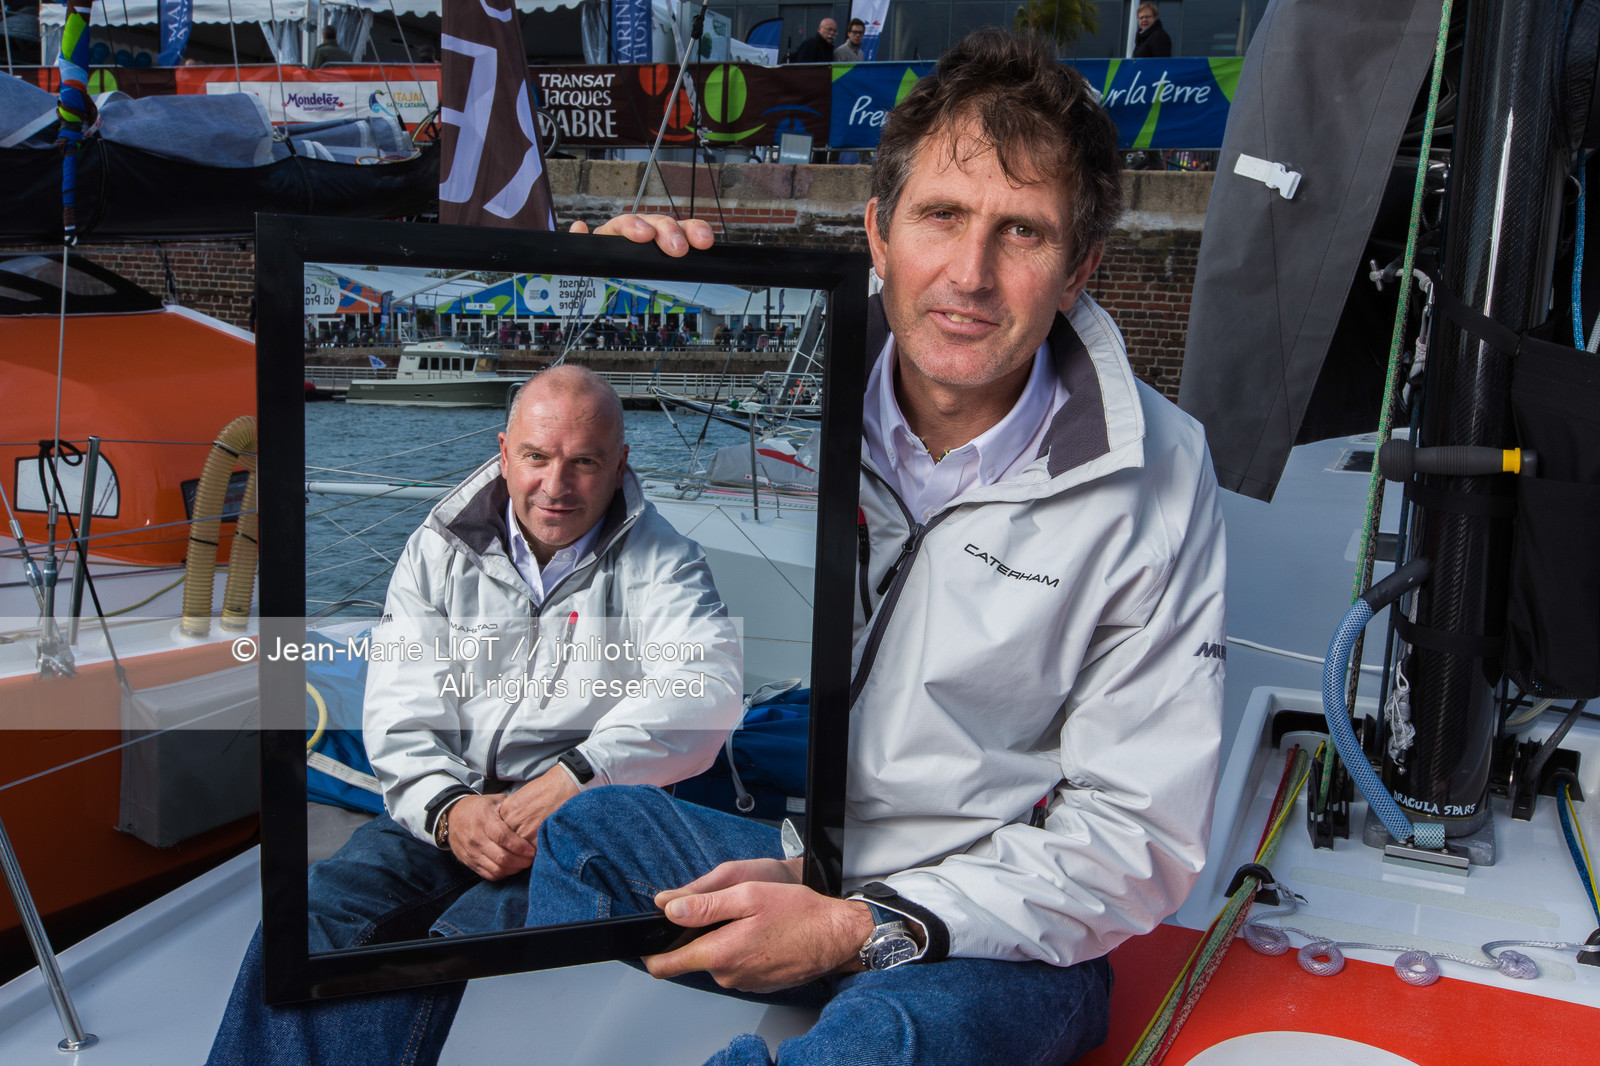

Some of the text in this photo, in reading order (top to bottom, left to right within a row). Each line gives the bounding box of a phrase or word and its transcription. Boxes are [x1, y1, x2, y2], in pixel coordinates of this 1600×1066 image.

[615, 0, 632, 63] ARIN
[538, 73, 616, 88] TRANSAT
[1151, 70, 1211, 104] terre
[542, 88, 612, 109] Jacques
[537, 109, 619, 138] VABRE
[963, 543, 1061, 588] CATERHAM
[1393, 789, 1477, 816] DRACULA SPARS
